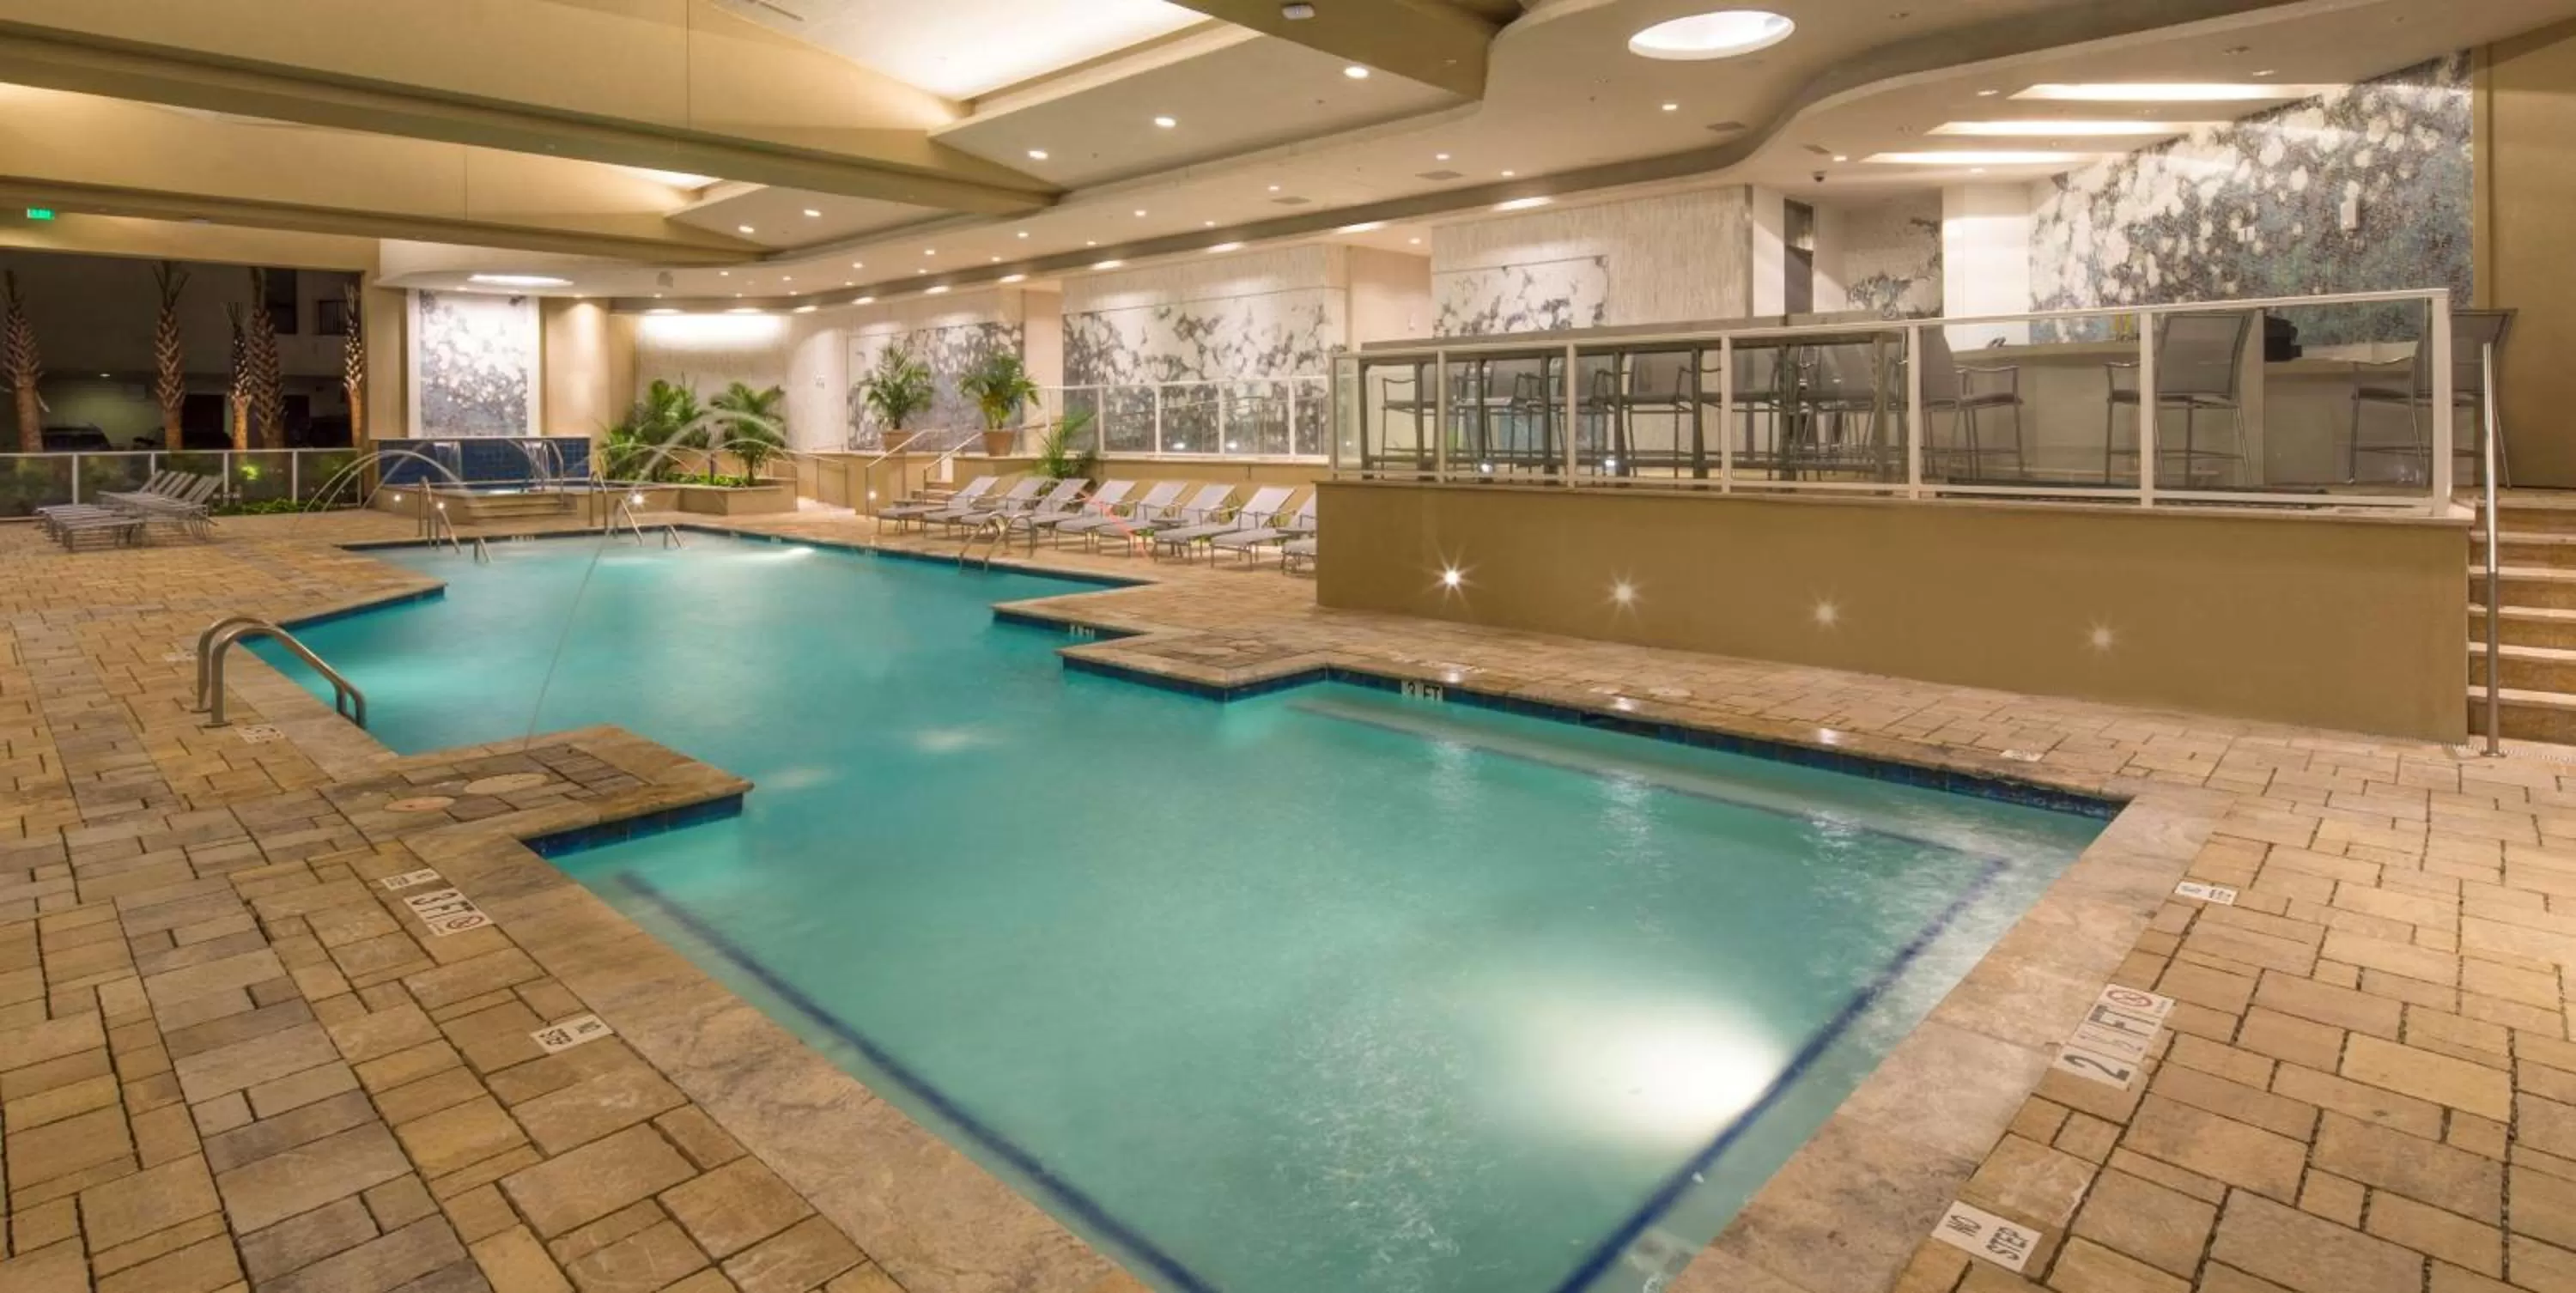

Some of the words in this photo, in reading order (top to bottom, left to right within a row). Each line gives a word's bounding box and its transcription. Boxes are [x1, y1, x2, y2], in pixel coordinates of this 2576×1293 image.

[1423, 685, 1440, 701] FT
[412, 892, 459, 906] 3
[419, 899, 475, 920] FT
[2088, 1005, 2156, 1037] FT
[2063, 1054, 2129, 1082] 2
[1946, 1214, 1983, 1236] NO
[1985, 1226, 2029, 1261] STEP
